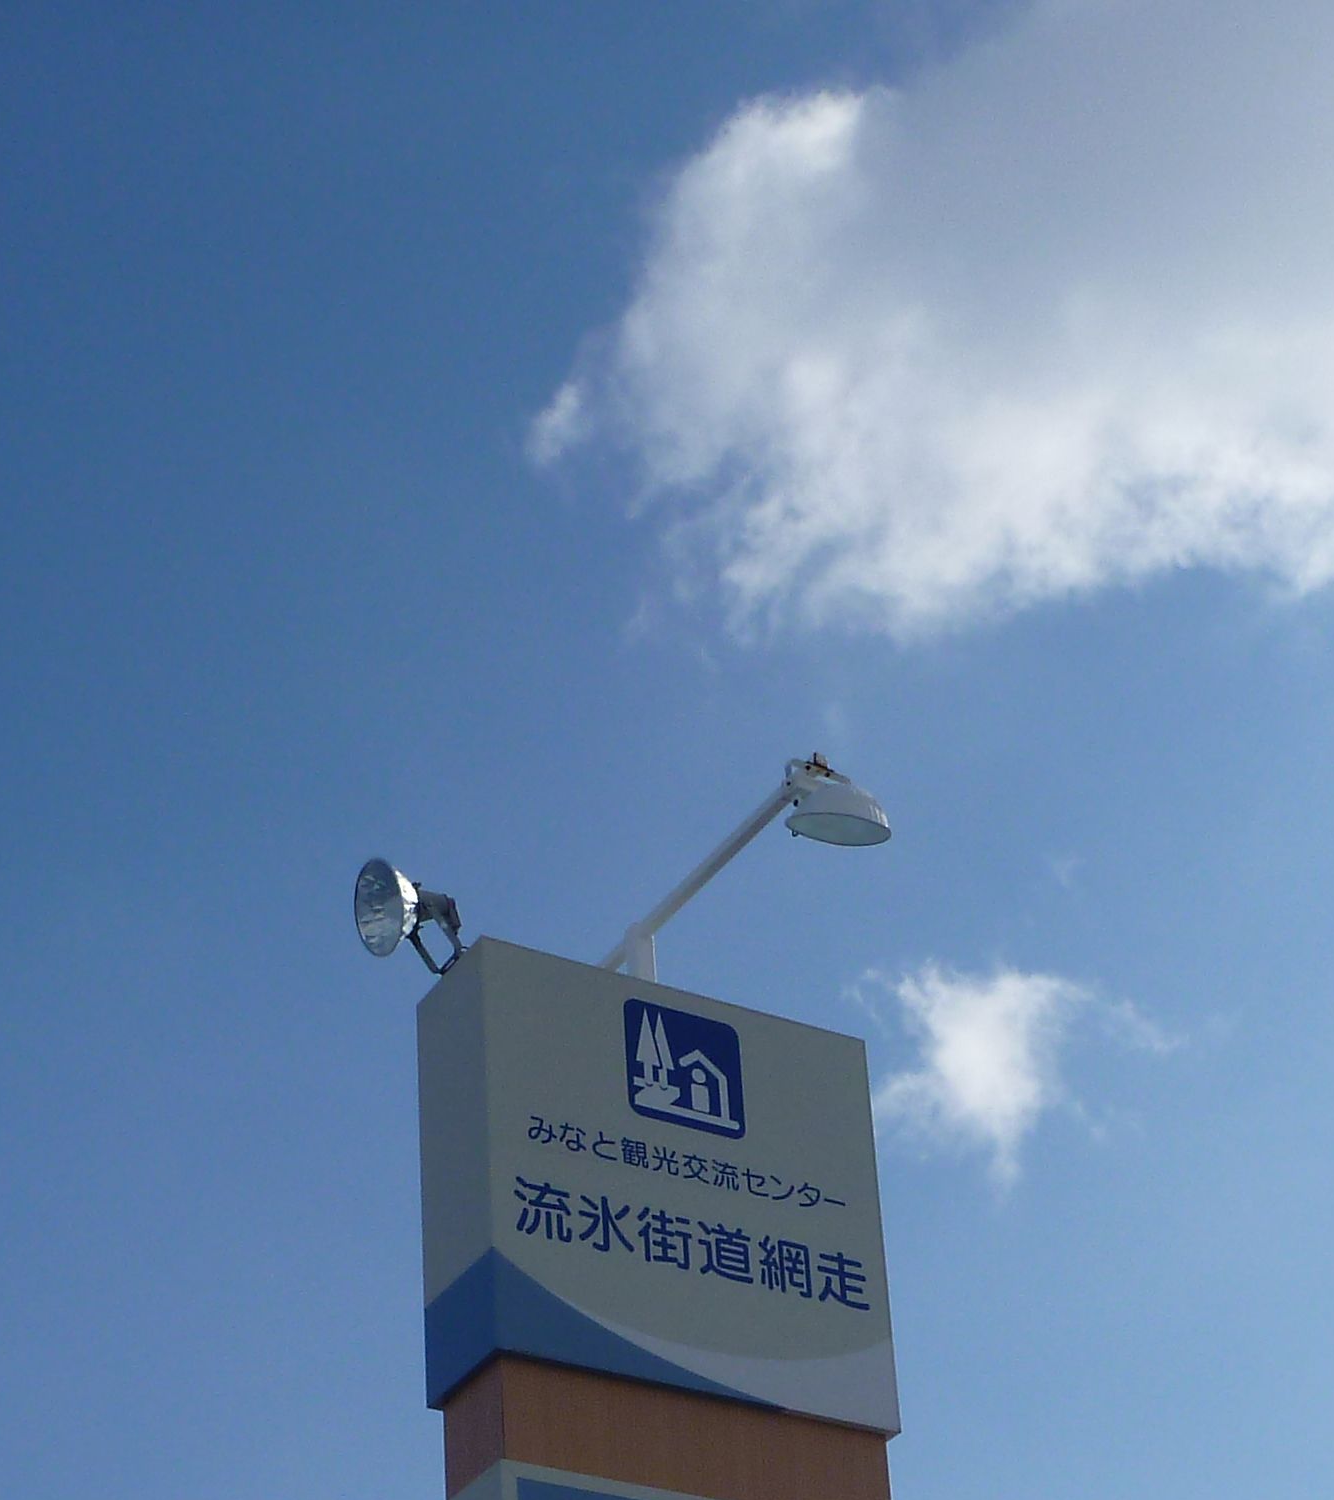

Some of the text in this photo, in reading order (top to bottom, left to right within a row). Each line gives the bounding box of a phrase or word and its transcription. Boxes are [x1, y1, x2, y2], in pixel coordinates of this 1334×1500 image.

[527, 1115, 846, 1208] みなと観光交流センター
[514, 1175, 870, 1311] 流氷街道網走
